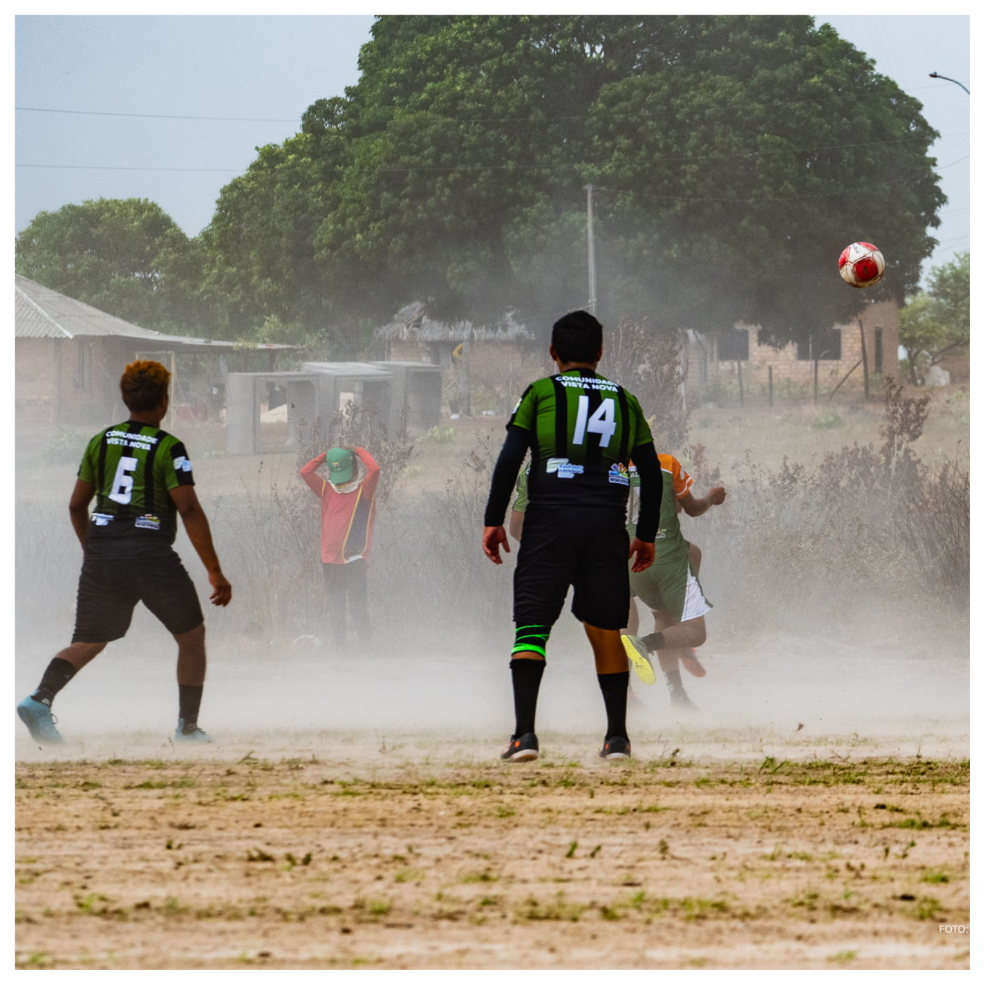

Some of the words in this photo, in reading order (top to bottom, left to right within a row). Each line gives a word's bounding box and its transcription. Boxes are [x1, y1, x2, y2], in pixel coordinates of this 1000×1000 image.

[561, 382, 590, 390] VISTA
[592, 384, 619, 393] NOVA
[572, 395, 617, 448] 14
[106, 430, 158, 444] COMUNIDADE
[106, 438, 128, 446] VISTA
[129, 441, 151, 451] NOVA
[108, 456, 138, 505] 6
